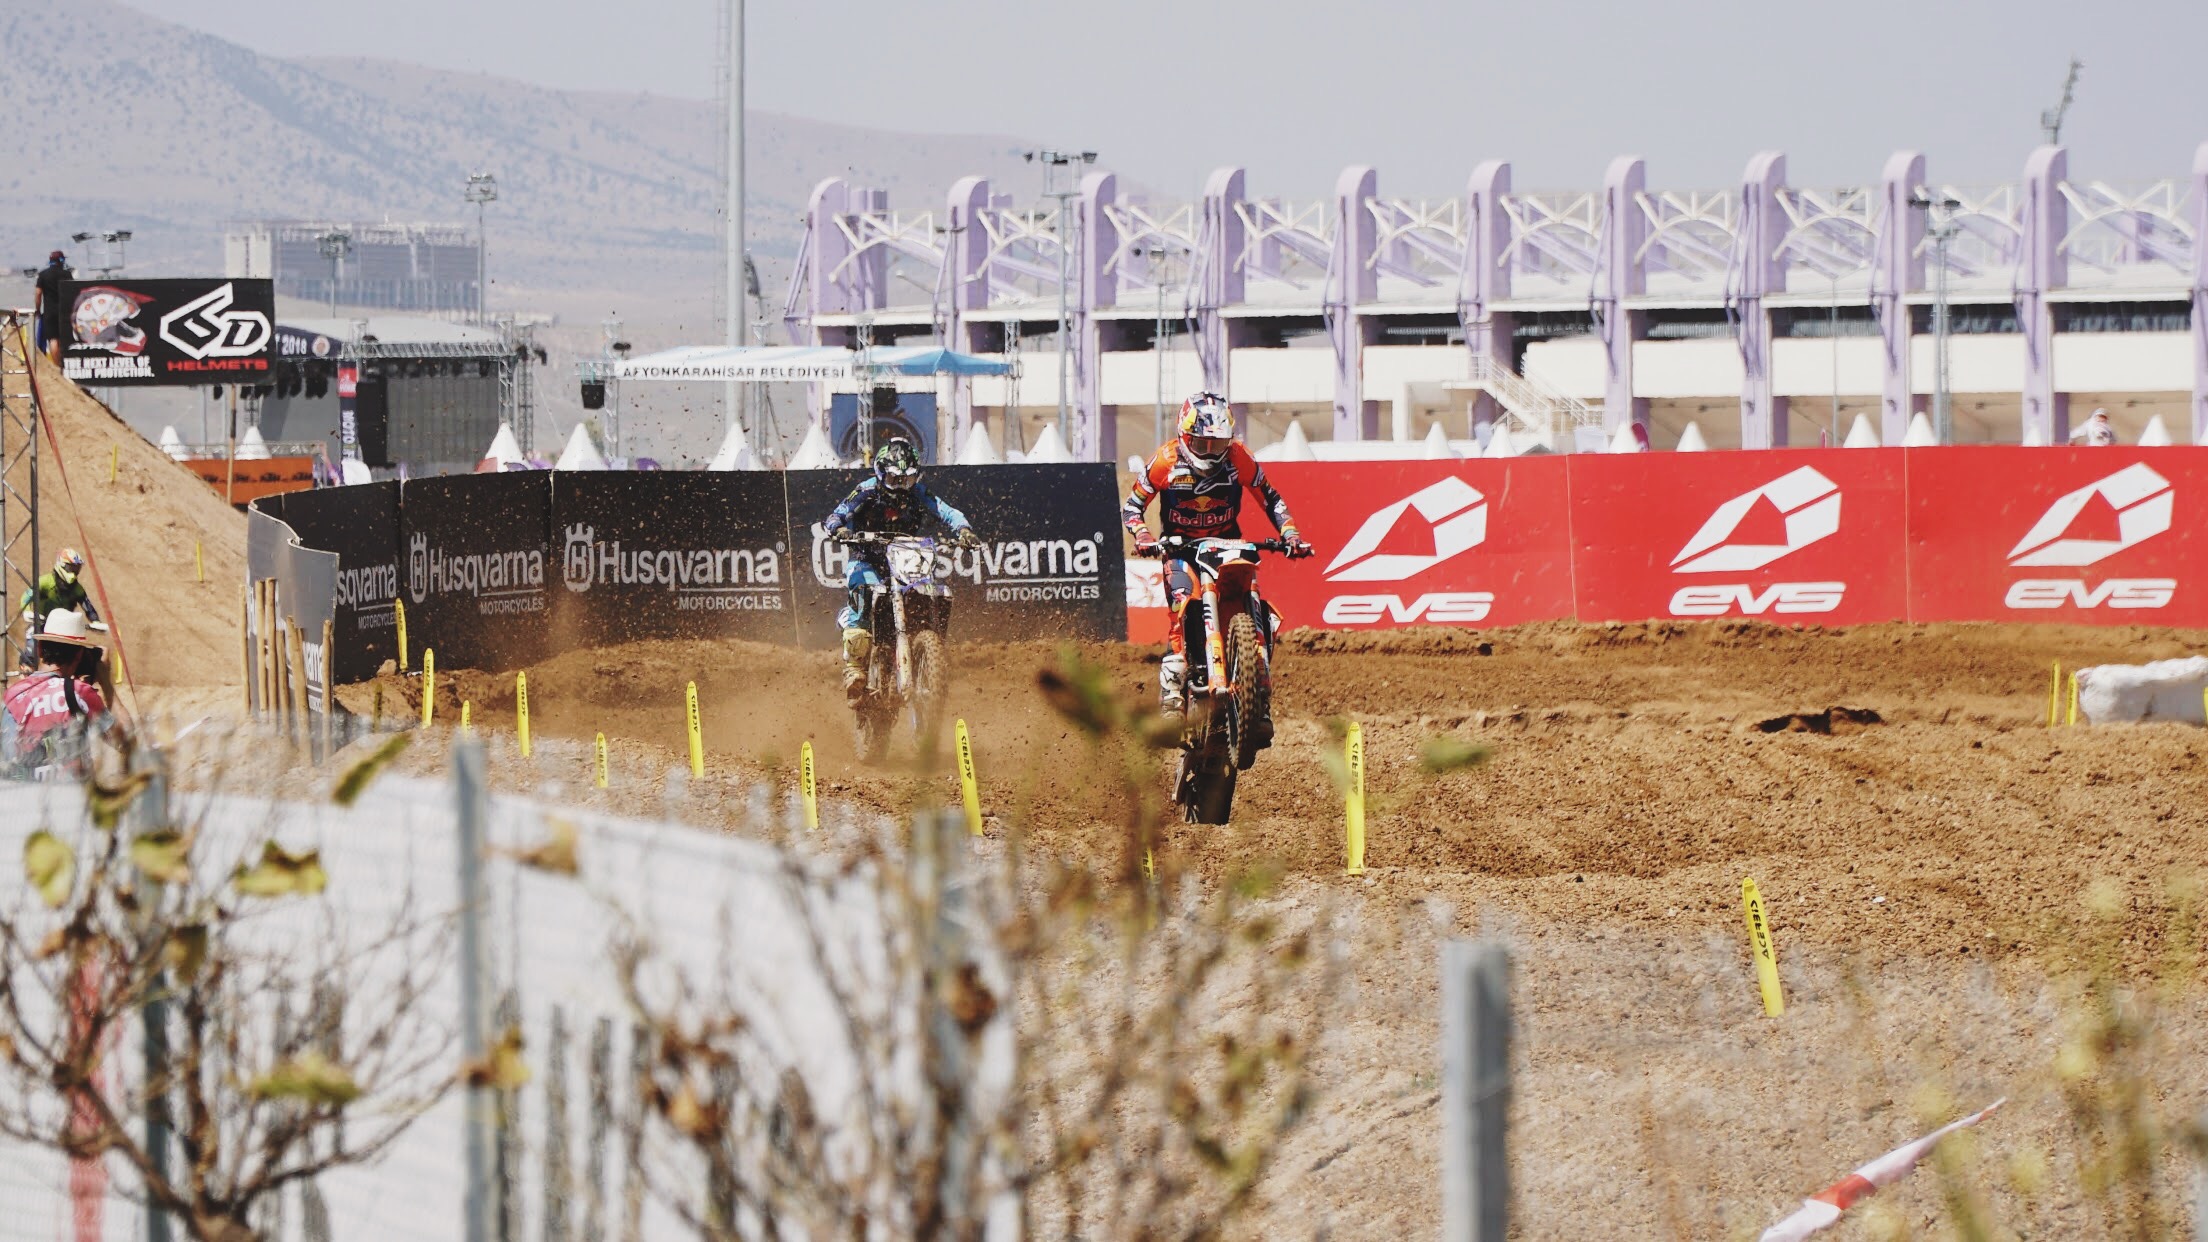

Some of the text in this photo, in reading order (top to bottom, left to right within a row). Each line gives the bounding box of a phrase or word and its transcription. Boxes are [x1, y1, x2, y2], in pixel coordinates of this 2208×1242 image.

[281, 334, 307, 355] 2018
[63, 355, 151, 369] THE NEXT LEVEL OF
[167, 358, 268, 371] HELMETS
[1169, 507, 1233, 527] Red Bull
[430, 546, 543, 598] Husqvarna
[600, 540, 780, 592] Husqvarna
[935, 538, 1100, 584] sqvarna
[336, 563, 397, 612] sqvarna
[679, 595, 782, 611] MOTORCYCLES
[986, 583, 1100, 603] MOTORCYCLES
[480, 597, 544, 616] MOTORCYCLES
[961, 735, 972, 780] ACERBIS
[804, 757, 812, 798] ACERBIS
[1750, 899, 1770, 960] ACERBIS
